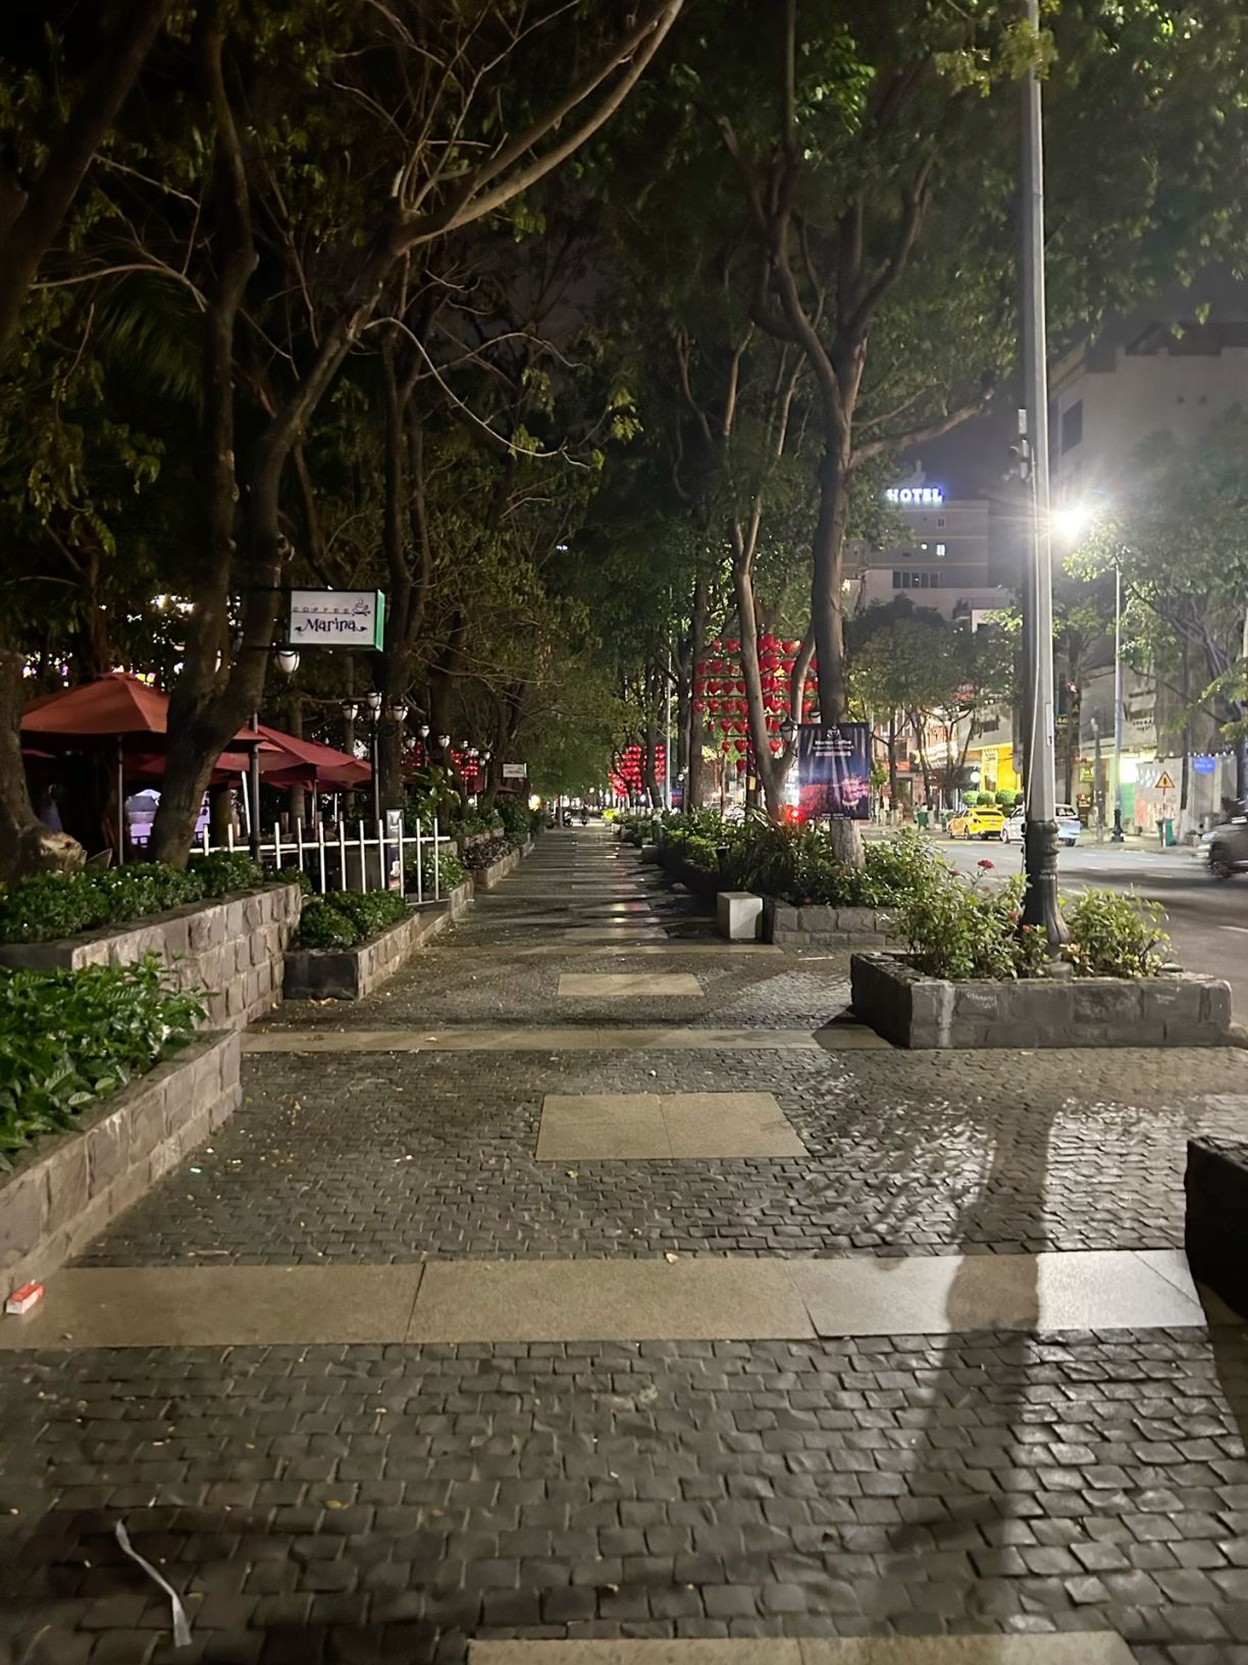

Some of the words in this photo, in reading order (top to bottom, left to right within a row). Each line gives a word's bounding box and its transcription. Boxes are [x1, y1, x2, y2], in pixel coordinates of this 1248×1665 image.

[886, 488, 943, 503] HOTEL
[292, 606, 350, 614] COFFEE
[304, 618, 356, 632] Marina
